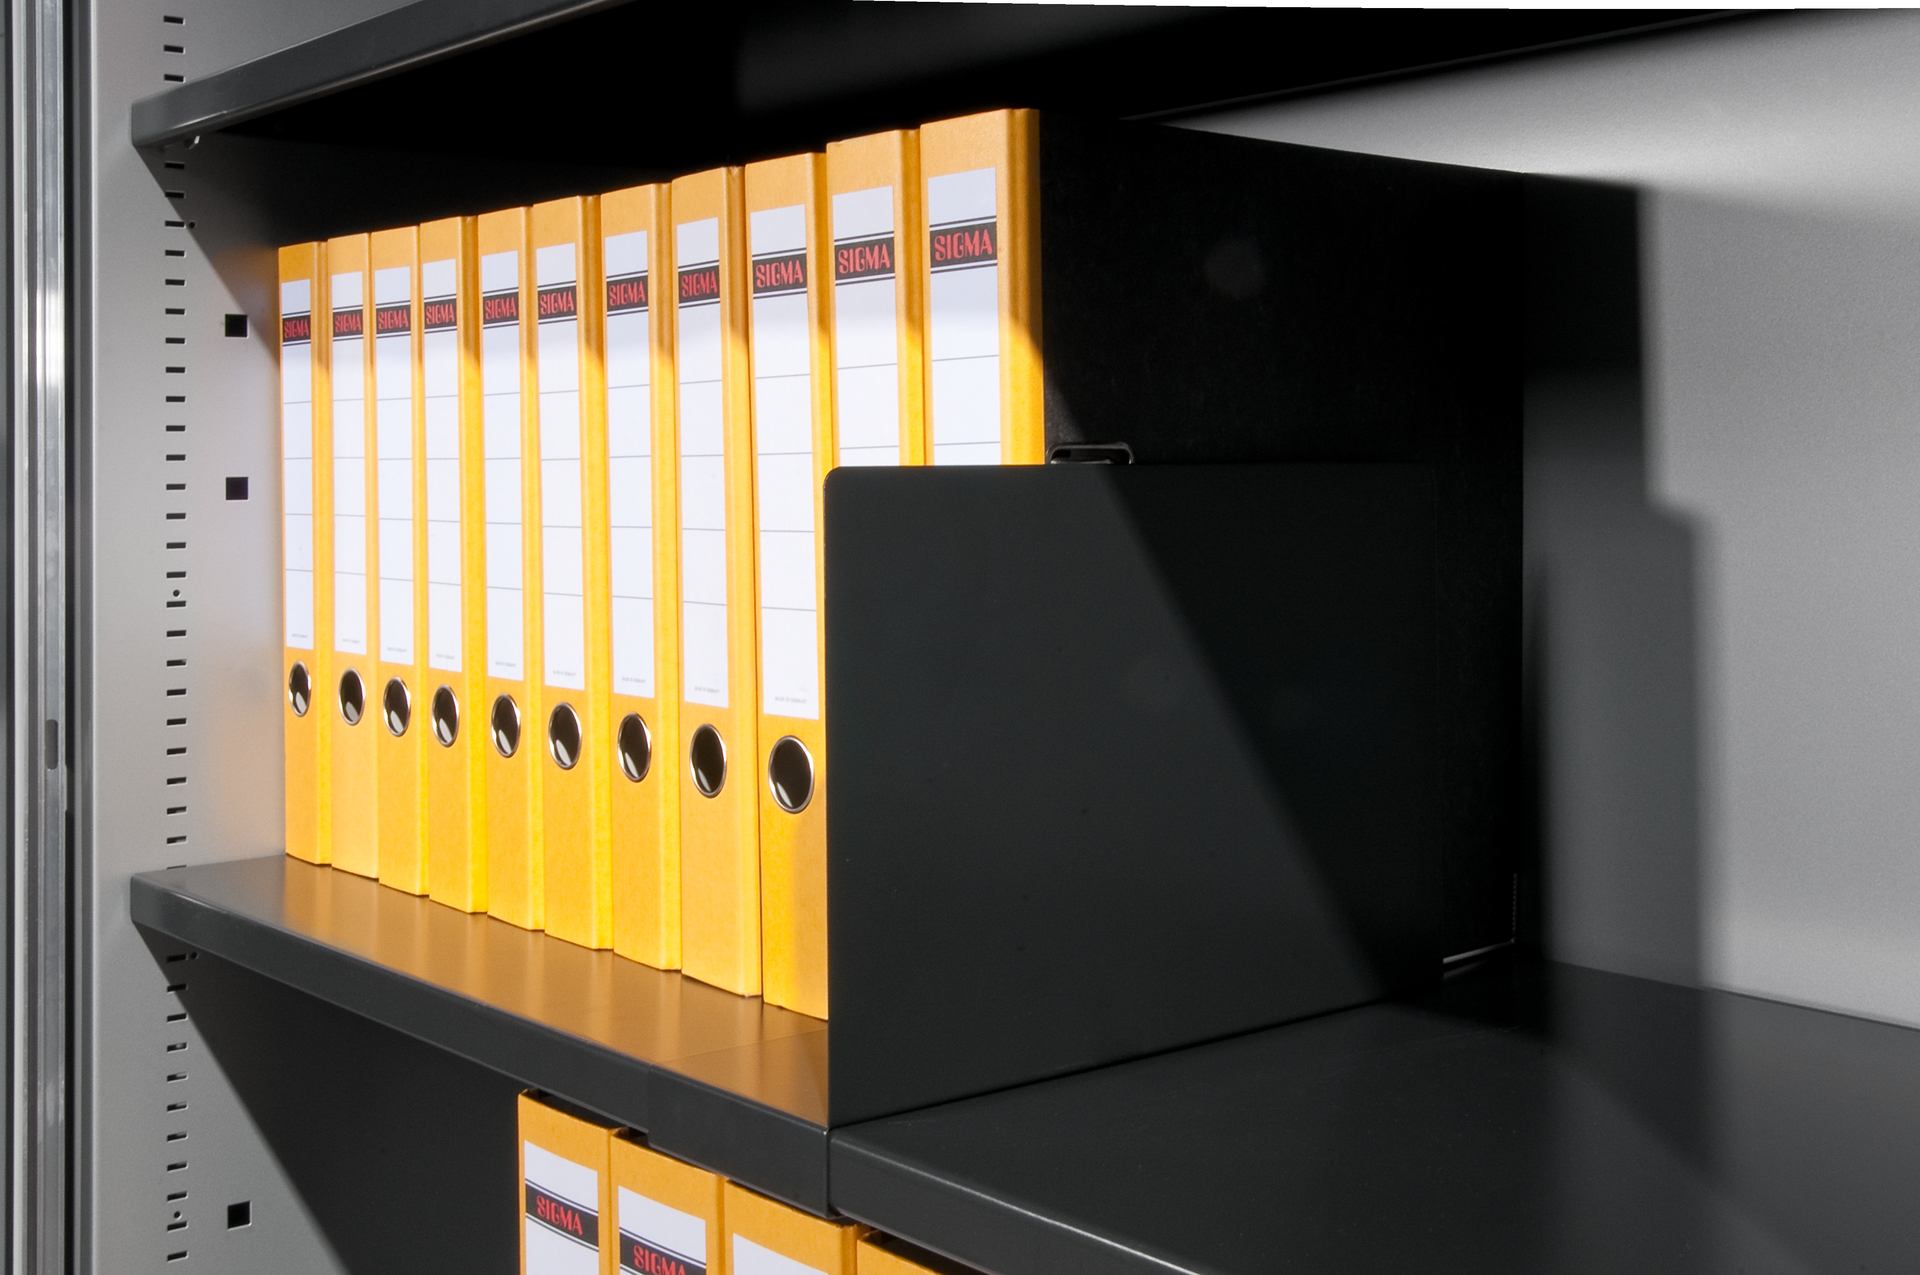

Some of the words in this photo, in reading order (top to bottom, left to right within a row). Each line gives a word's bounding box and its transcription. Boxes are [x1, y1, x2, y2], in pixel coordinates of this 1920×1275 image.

[933, 228, 993, 261] SIGMA
[837, 244, 891, 275] SIGMA
[680, 271, 718, 298] SIGMA
[755, 259, 804, 288] SIGMA
[539, 291, 575, 316] SIGMA
[608, 279, 646, 307] SIGMA
[377, 307, 410, 332] SIGMA
[425, 302, 456, 326] SIGMA
[484, 295, 518, 321] SIGMA
[283, 319, 310, 340] SIGMA
[334, 312, 362, 334] SIGMA
[536, 1195, 583, 1236] SIGMA
